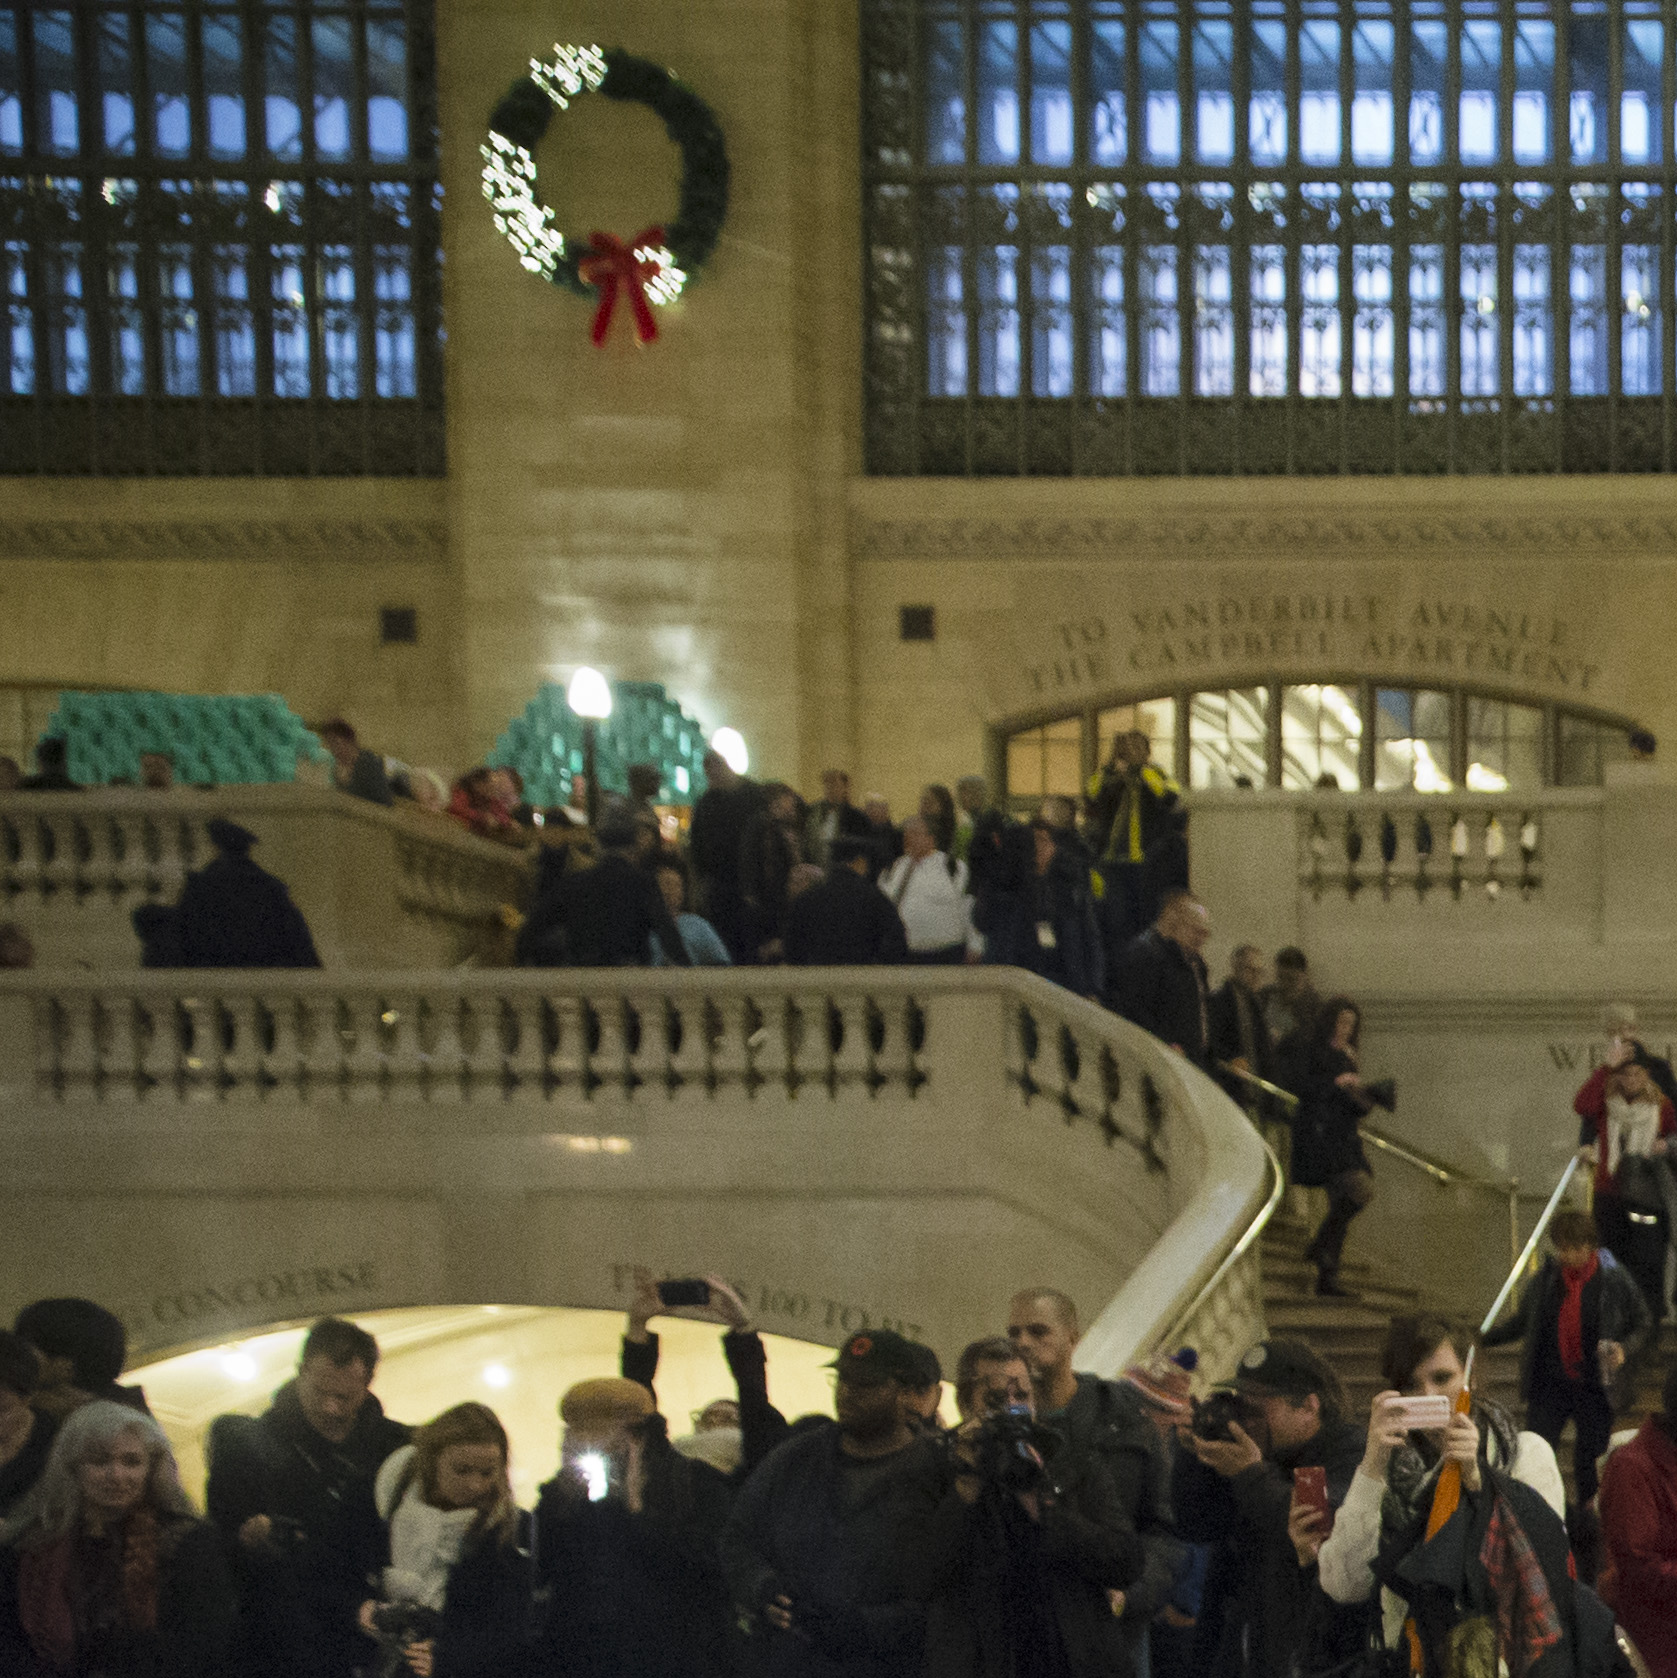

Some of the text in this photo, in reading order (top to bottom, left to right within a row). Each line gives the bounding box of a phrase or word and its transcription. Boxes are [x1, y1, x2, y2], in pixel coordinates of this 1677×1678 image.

[1059, 596, 1571, 650] TO VANDERBILT AVENUE
[1026, 631, 1600, 692] THE CAMPBELL APARTMENT
[153, 1261, 377, 1324] CONCOURSE
